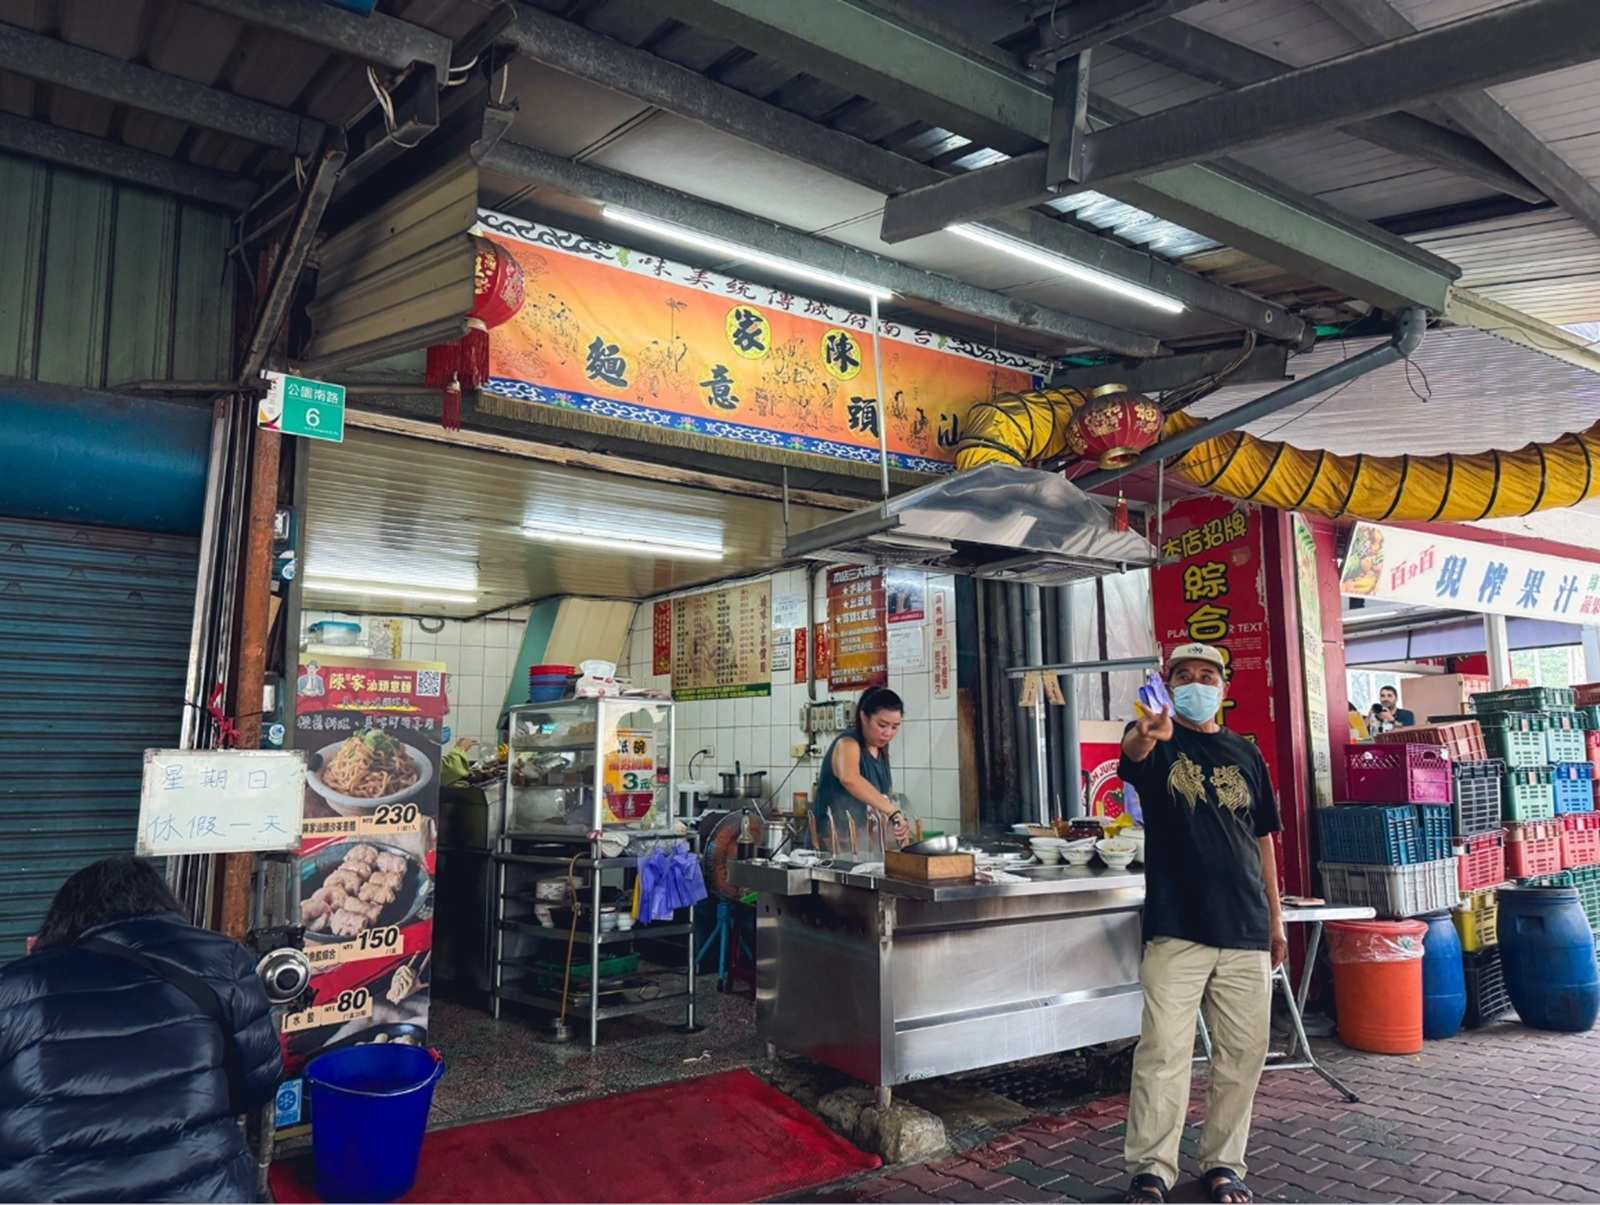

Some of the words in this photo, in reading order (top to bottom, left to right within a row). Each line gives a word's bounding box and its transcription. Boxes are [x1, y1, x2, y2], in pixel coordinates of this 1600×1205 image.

[287, 383, 339, 405] 公園南路
[305, 408, 321, 427] 6
[1162, 511, 1247, 558] 本店招牌
[1390, 545, 1436, 591] 百分百
[1436, 554, 1579, 614] 現榨果汁
[1238, 623, 1263, 634] TEXT
[162, 764, 269, 791] 星期日
[374, 804, 417, 825] 230
[148, 813, 288, 844] 休假一天
[359, 927, 398, 950] 150
[337, 989, 367, 1013] 80
